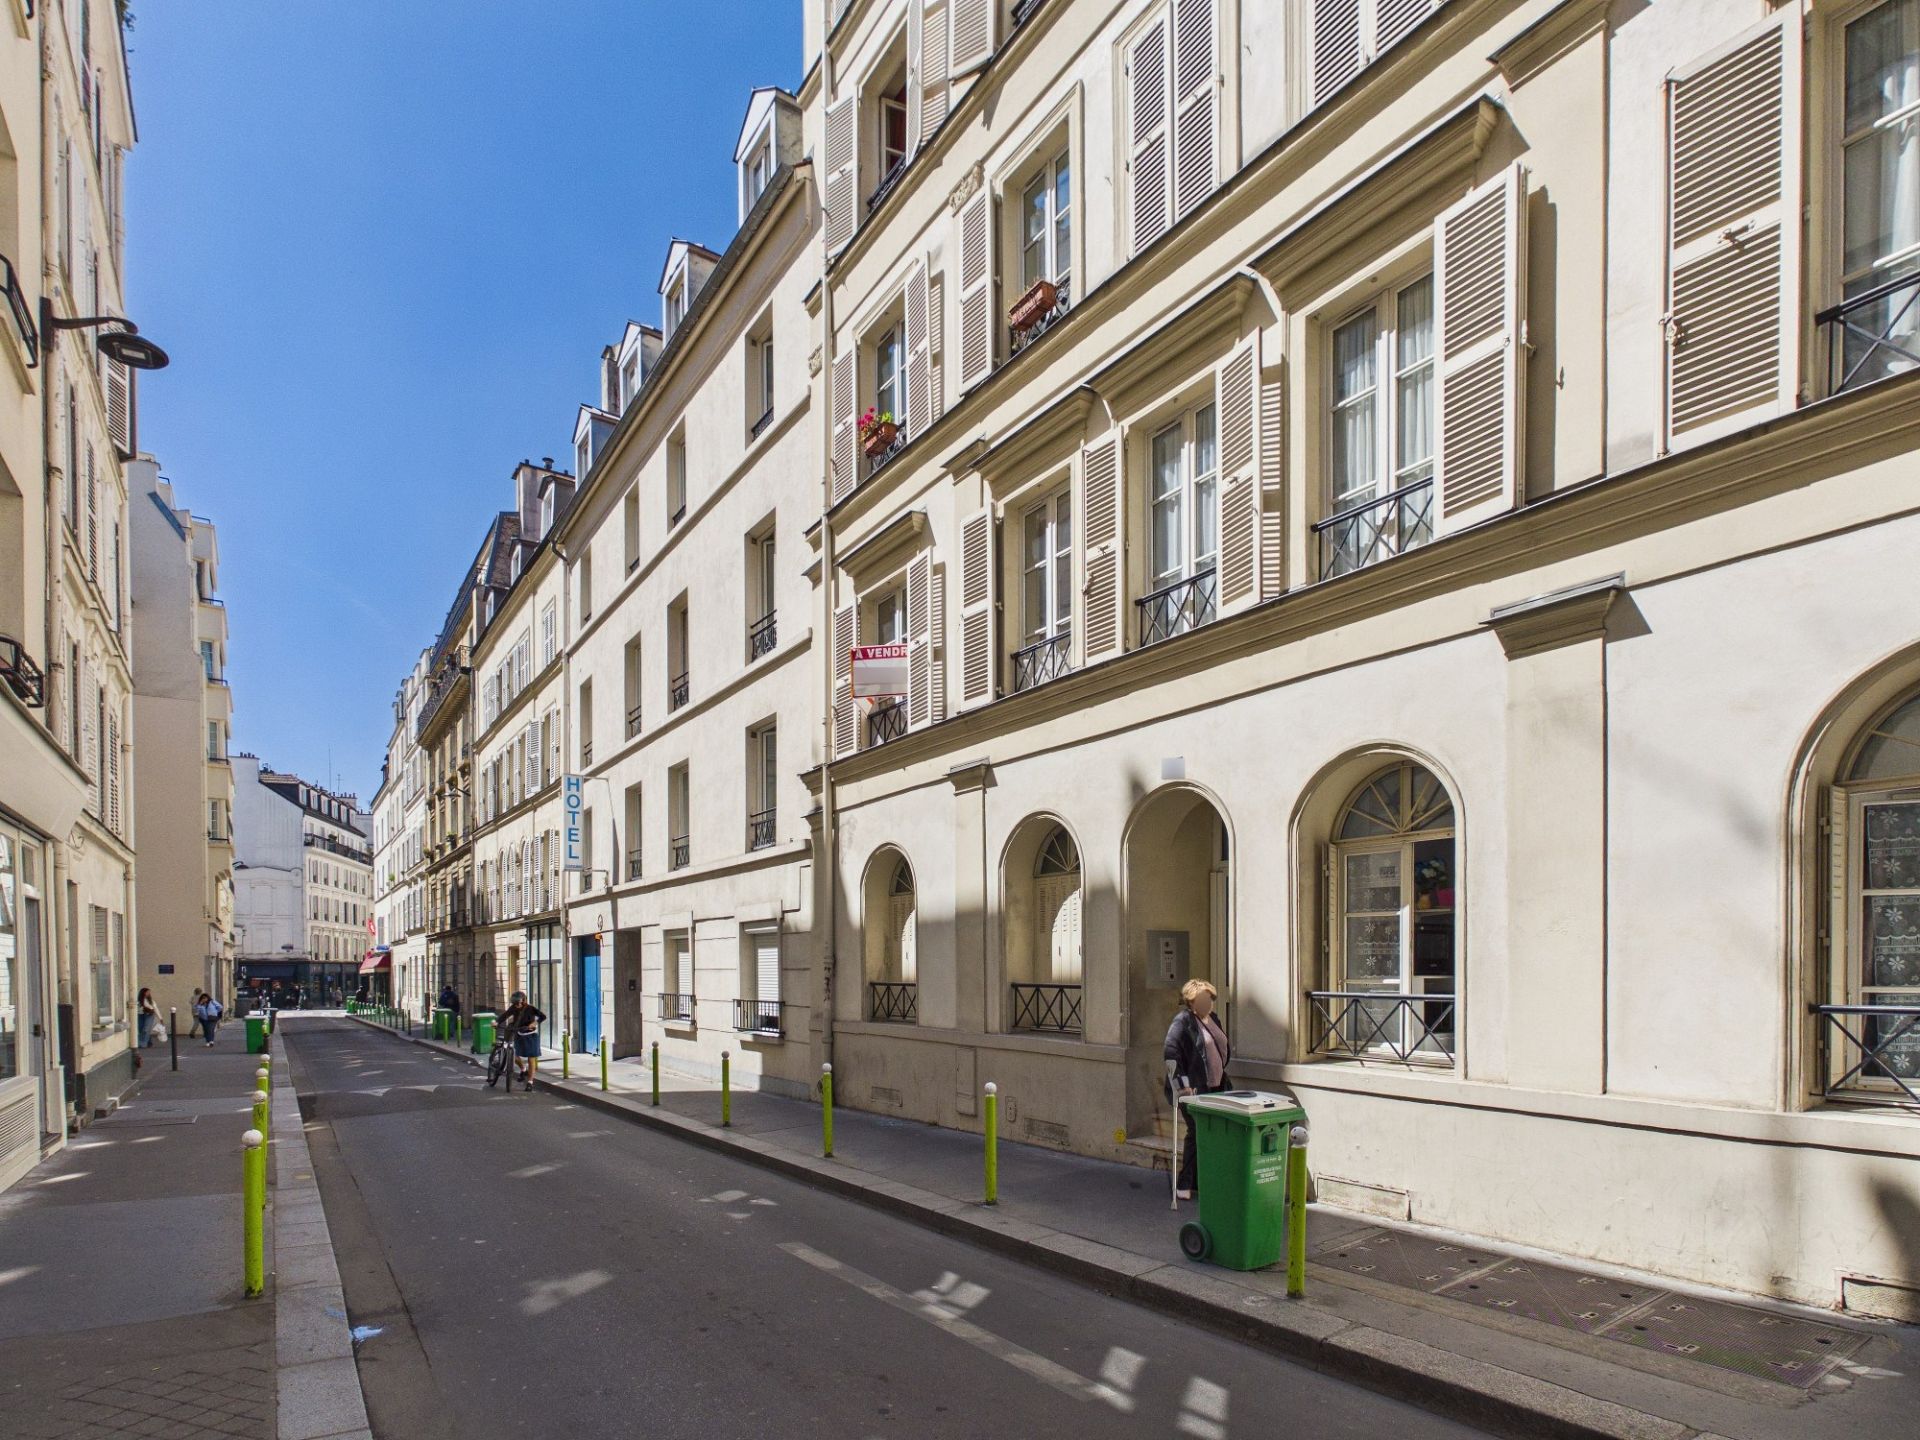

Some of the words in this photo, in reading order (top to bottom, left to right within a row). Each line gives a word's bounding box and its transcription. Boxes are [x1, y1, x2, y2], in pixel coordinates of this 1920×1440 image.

[855, 648, 863, 659] A
[867, 646, 907, 658] VENDR
[567, 777, 580, 859] HOTEL
